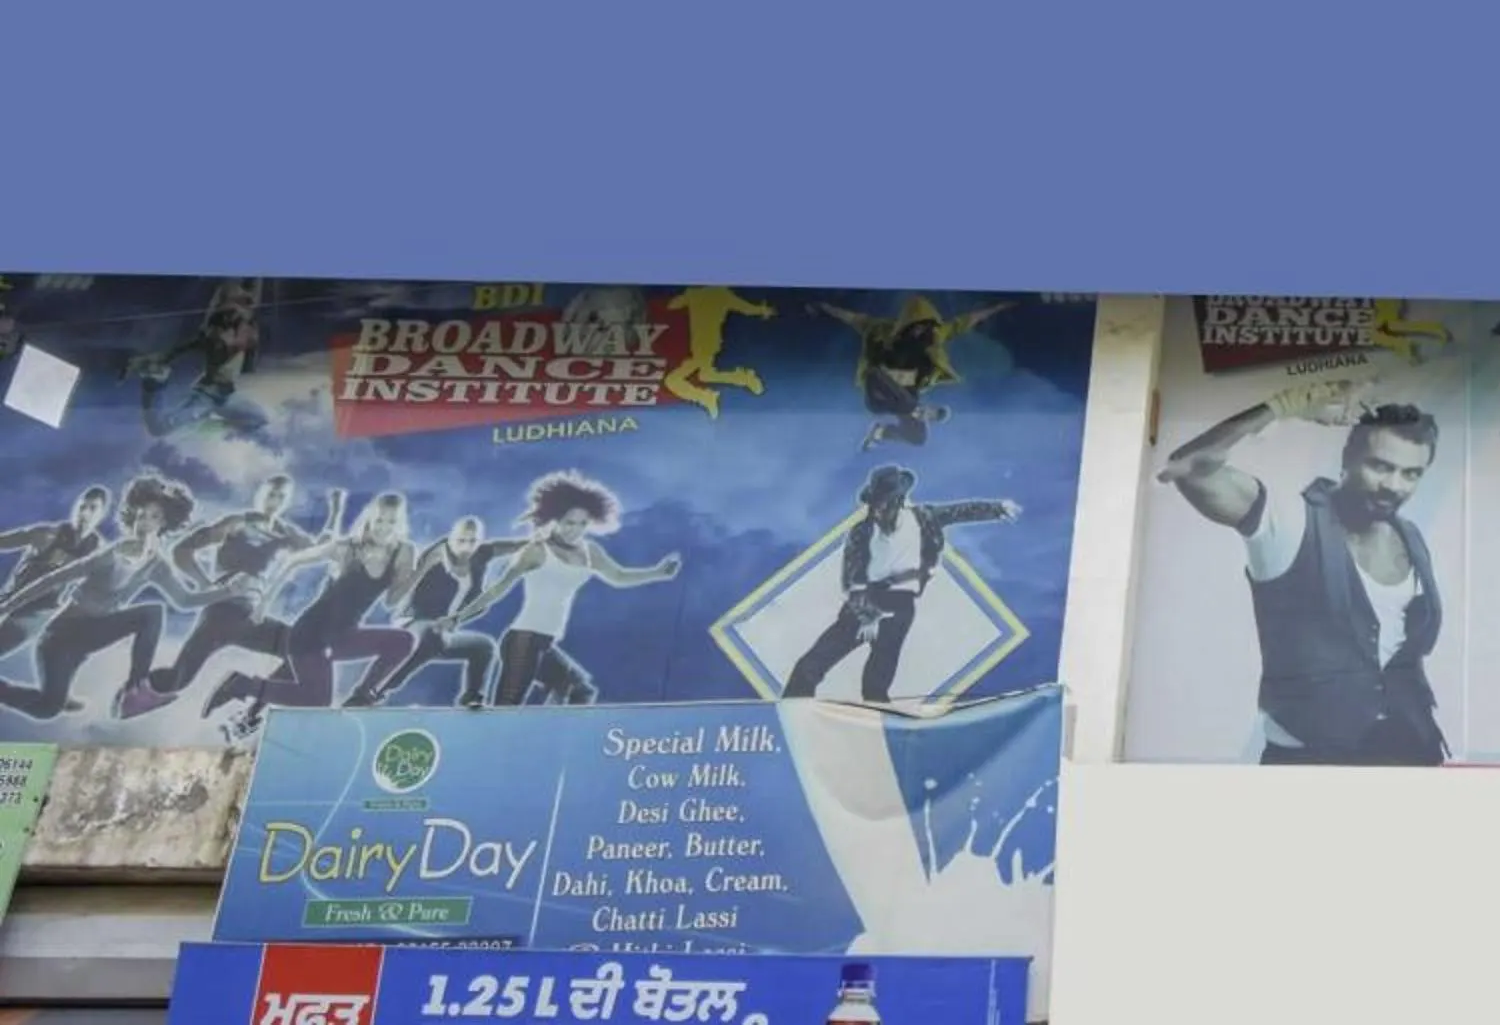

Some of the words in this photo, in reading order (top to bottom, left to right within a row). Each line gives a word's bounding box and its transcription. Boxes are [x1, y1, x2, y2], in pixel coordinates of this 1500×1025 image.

[473, 283, 544, 310] BDI
[1206, 306, 1374, 326] DANCE
[351, 319, 669, 356] BROADWAY
[1202, 325, 1374, 346] INSTITUTE
[346, 353, 670, 380] DANCE
[338, 378, 662, 406] INSTITUTE
[492, 416, 639, 445] LUDHIANA
[603, 727, 705, 761] Special
[628, 764, 677, 790] Cow
[617, 799, 669, 824] Desi
[325, 903, 371, 922] Fresh
[408, 901, 449, 921] Pure
[592, 905, 666, 932] Chatti
[675, 904, 738, 929] Lassi
[569, 961, 625, 1020] ਦੀ
